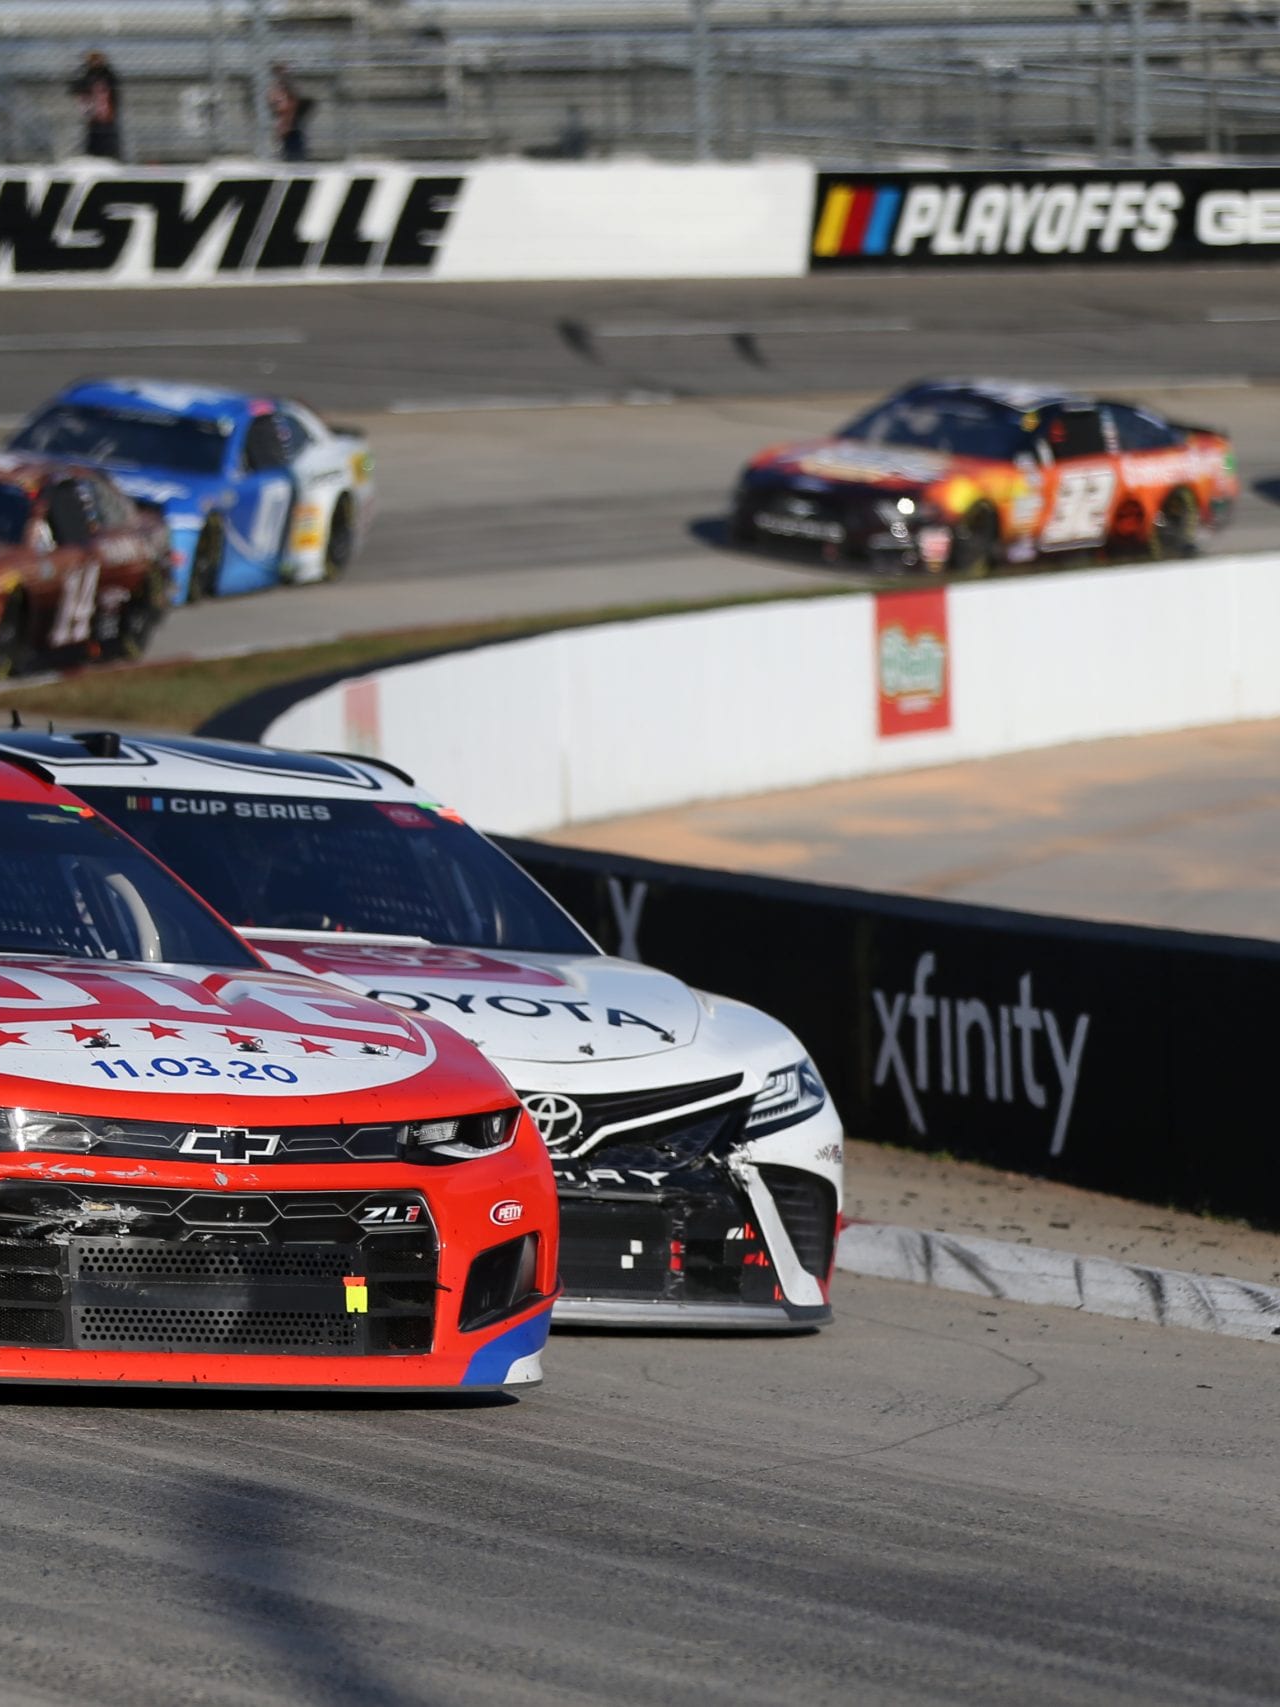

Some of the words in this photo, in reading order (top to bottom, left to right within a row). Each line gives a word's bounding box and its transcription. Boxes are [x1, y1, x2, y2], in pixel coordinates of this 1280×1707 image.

[893, 181, 1183, 256] PLAYOFFS
[170, 796, 228, 816] CUP
[234, 801, 332, 822] SERIES
[366, 990, 668, 1034] OYOTA
[873, 951, 1090, 1157] xfinity
[91, 1056, 299, 1084] 11.03.20
[358, 1205, 421, 1224] ZL1
[498, 1204, 523, 1220] PETTY
